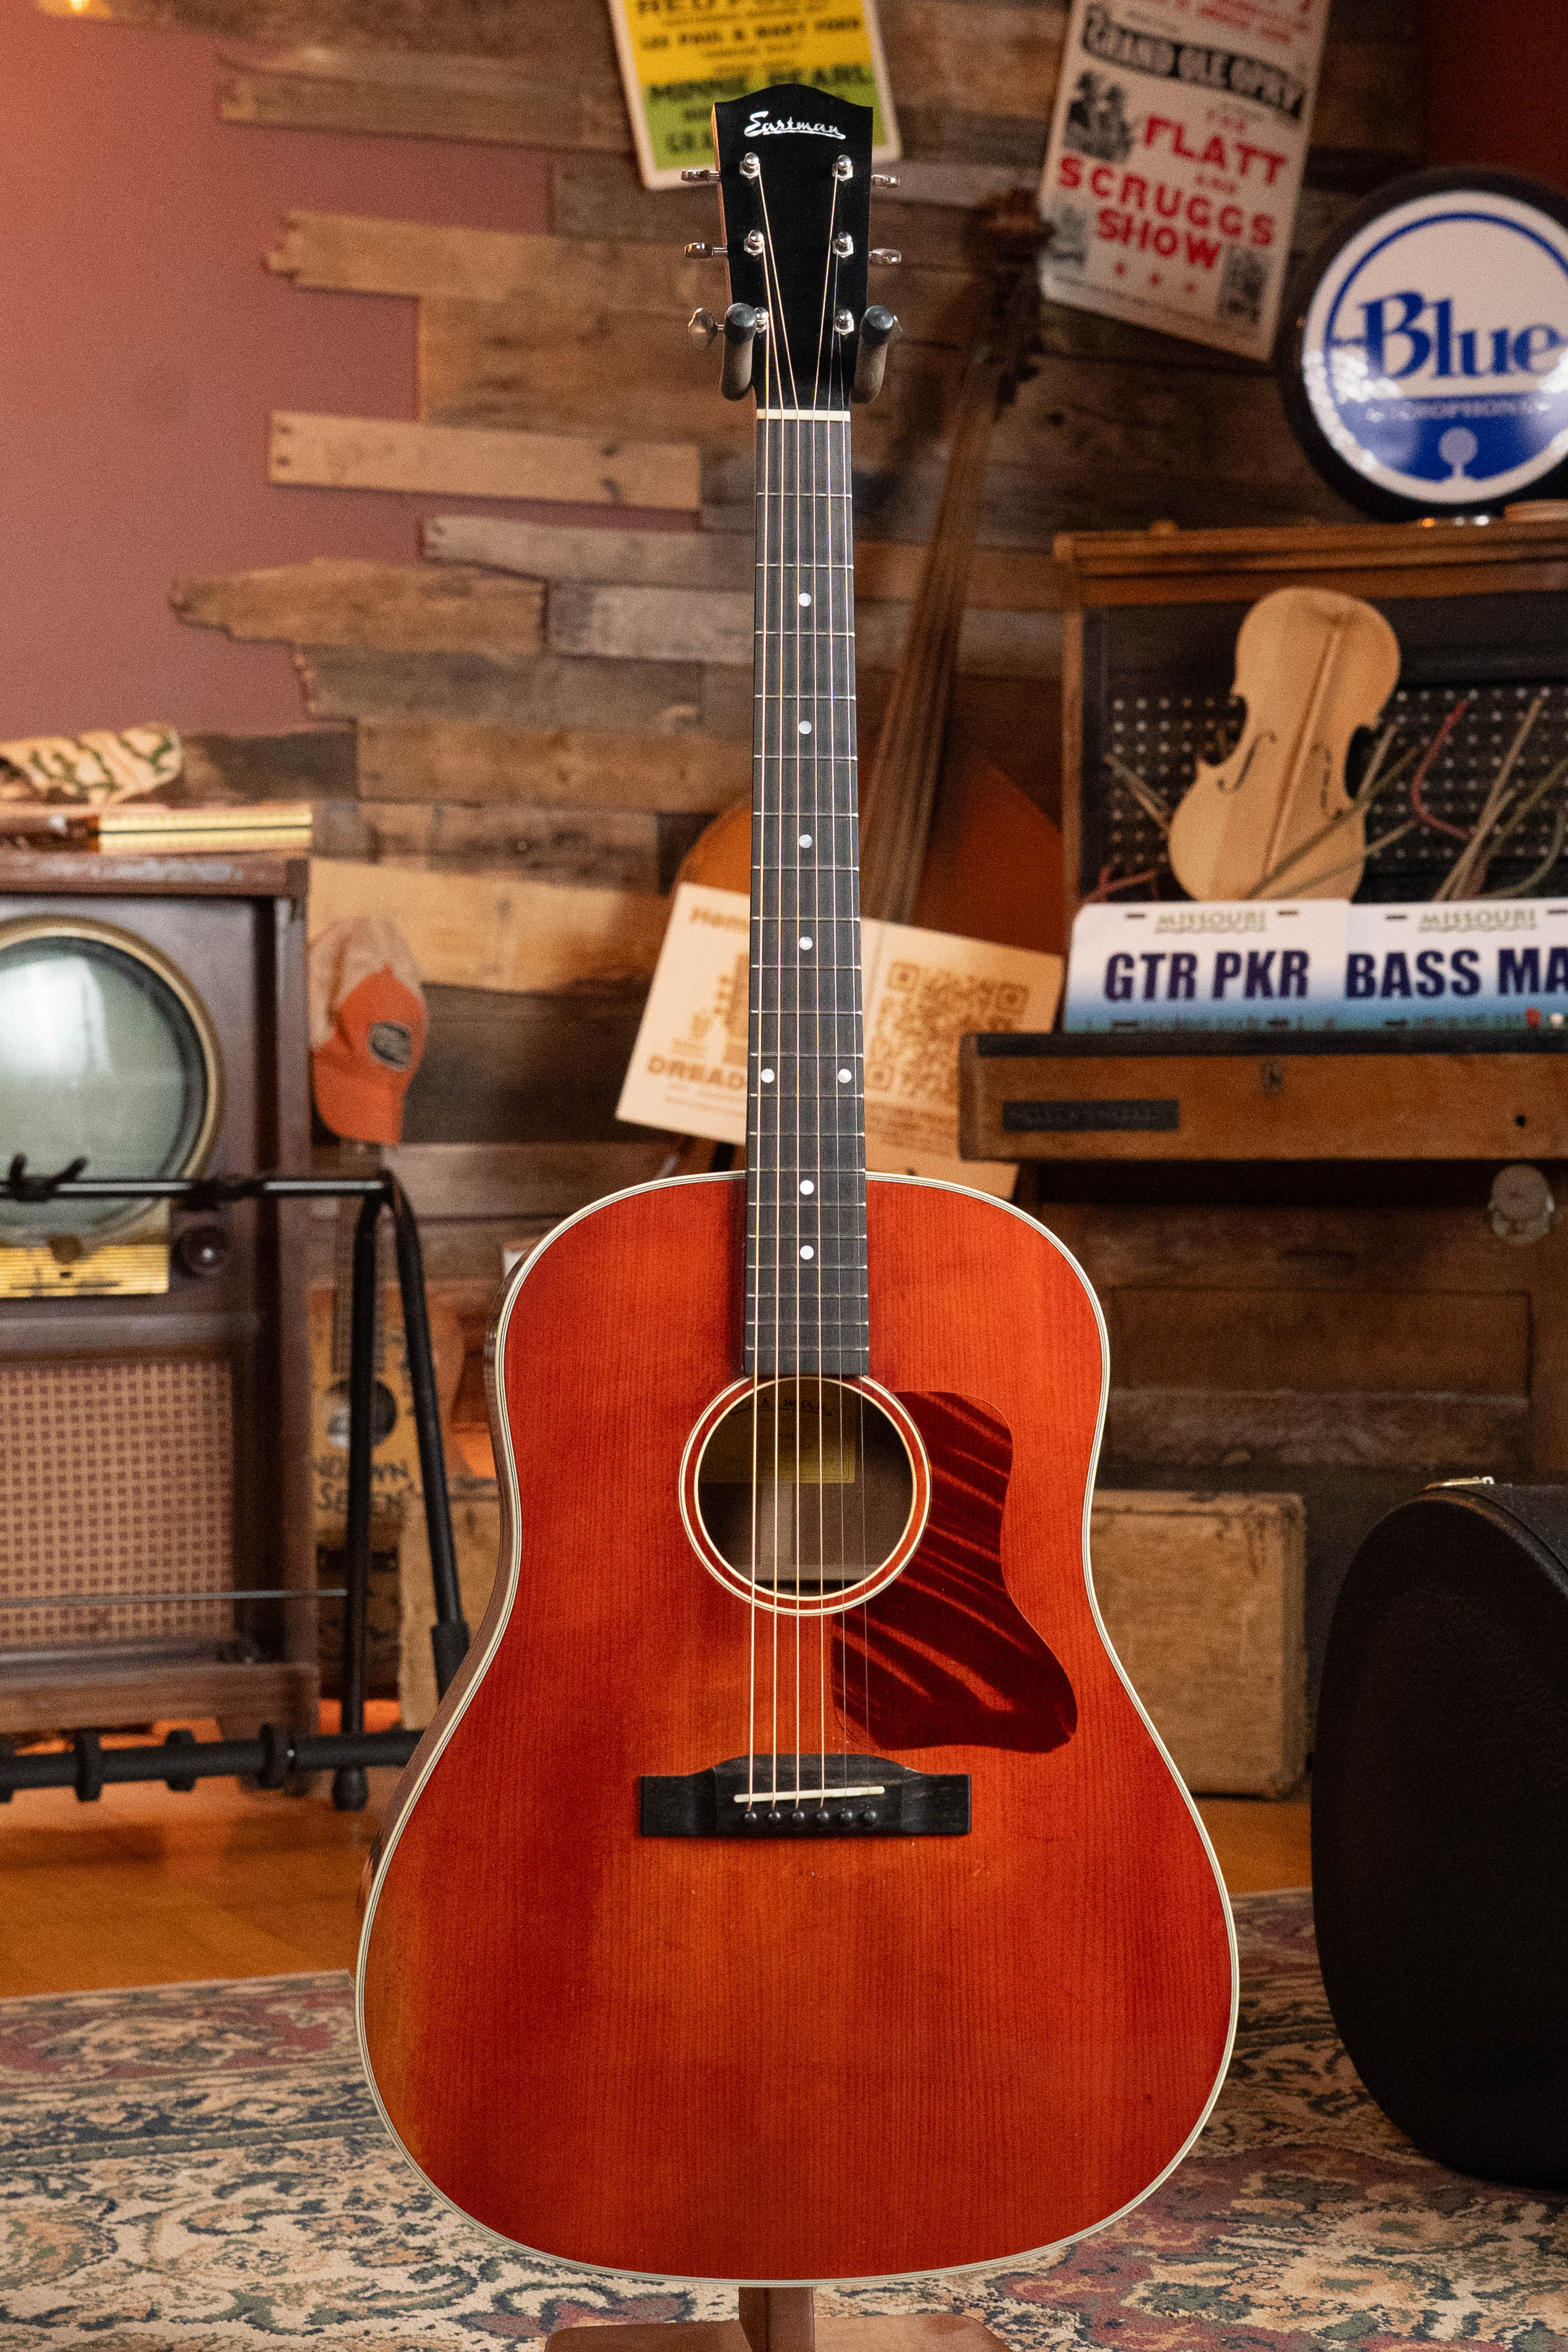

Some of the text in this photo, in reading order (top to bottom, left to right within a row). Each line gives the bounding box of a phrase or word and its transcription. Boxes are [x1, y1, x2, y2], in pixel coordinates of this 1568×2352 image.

[743, 111, 846, 140] Eastman
[1144, 114, 1286, 185] FLATT
[1058, 154, 1275, 247] SCRUGGS
[1097, 207, 1221, 270] SHOW
[1360, 290, 1564, 379] Blue
[1156, 911, 1267, 930] MISSOURI
[1419, 909, 1536, 929] MISSOURI
[1104, 949, 1310, 1001] GTR PKR
[1345, 949, 1481, 999] BASS
